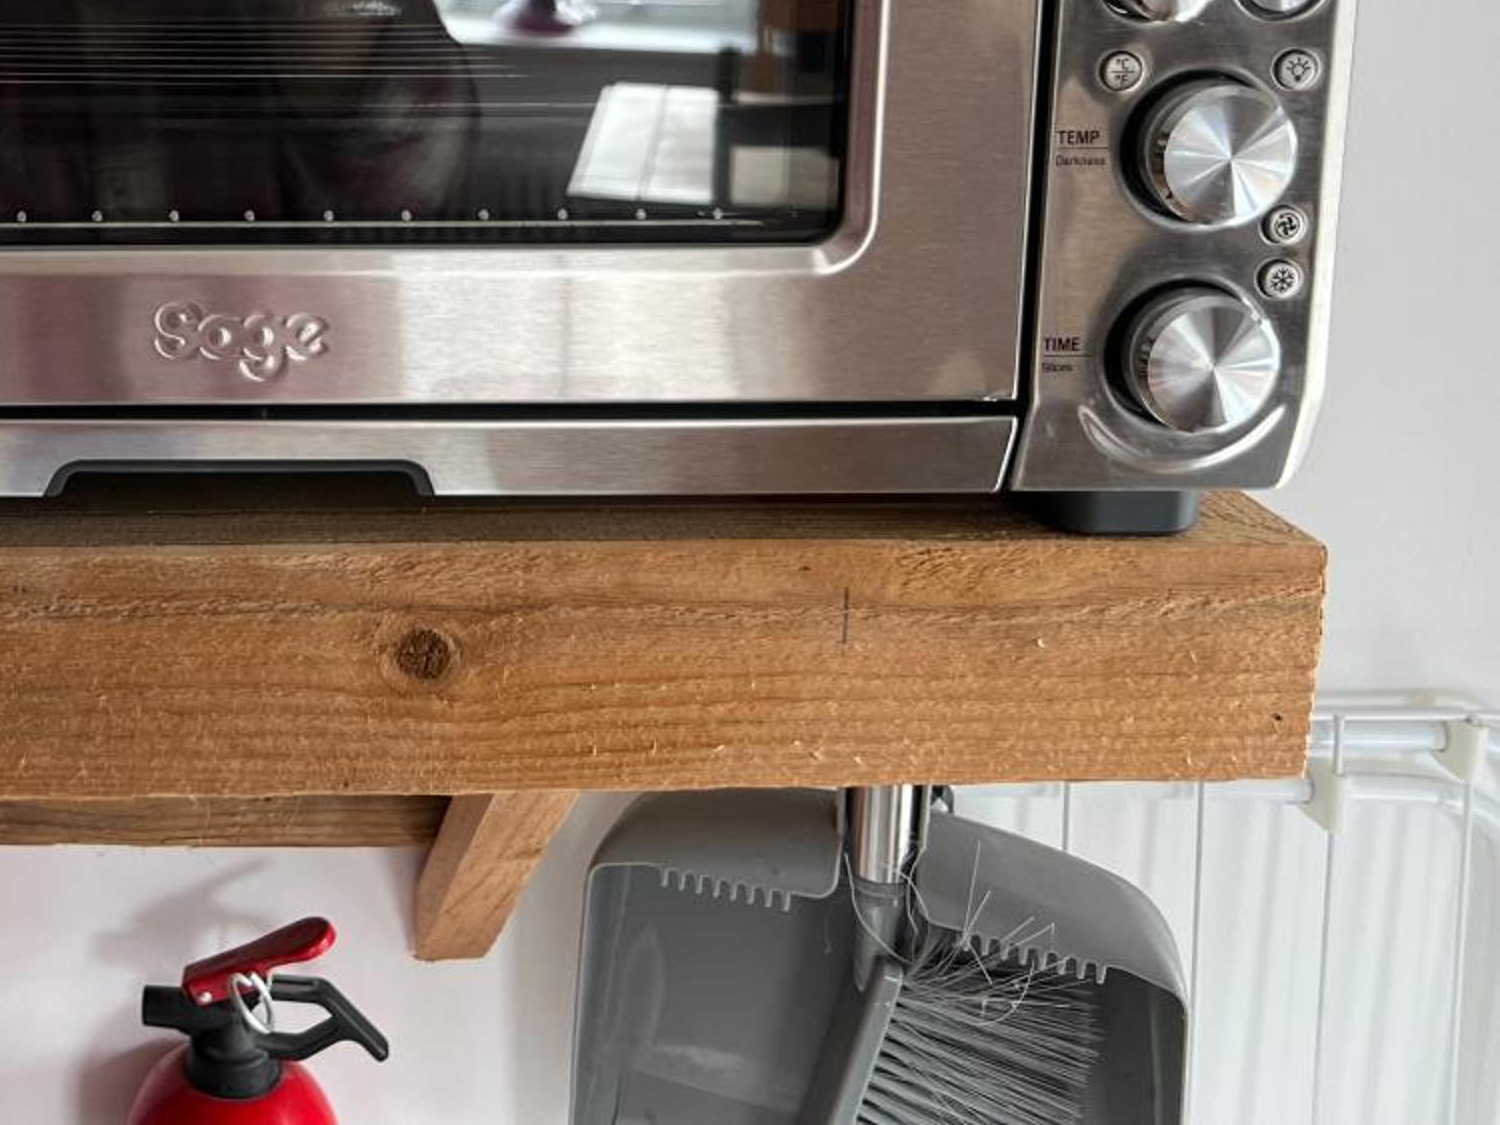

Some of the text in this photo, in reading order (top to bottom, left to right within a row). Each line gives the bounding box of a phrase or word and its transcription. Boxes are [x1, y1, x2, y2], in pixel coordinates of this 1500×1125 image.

[1056, 130, 1101, 145] TEMP
[153, 302, 329, 383] Sage
[1043, 336, 1081, 352] TIME
